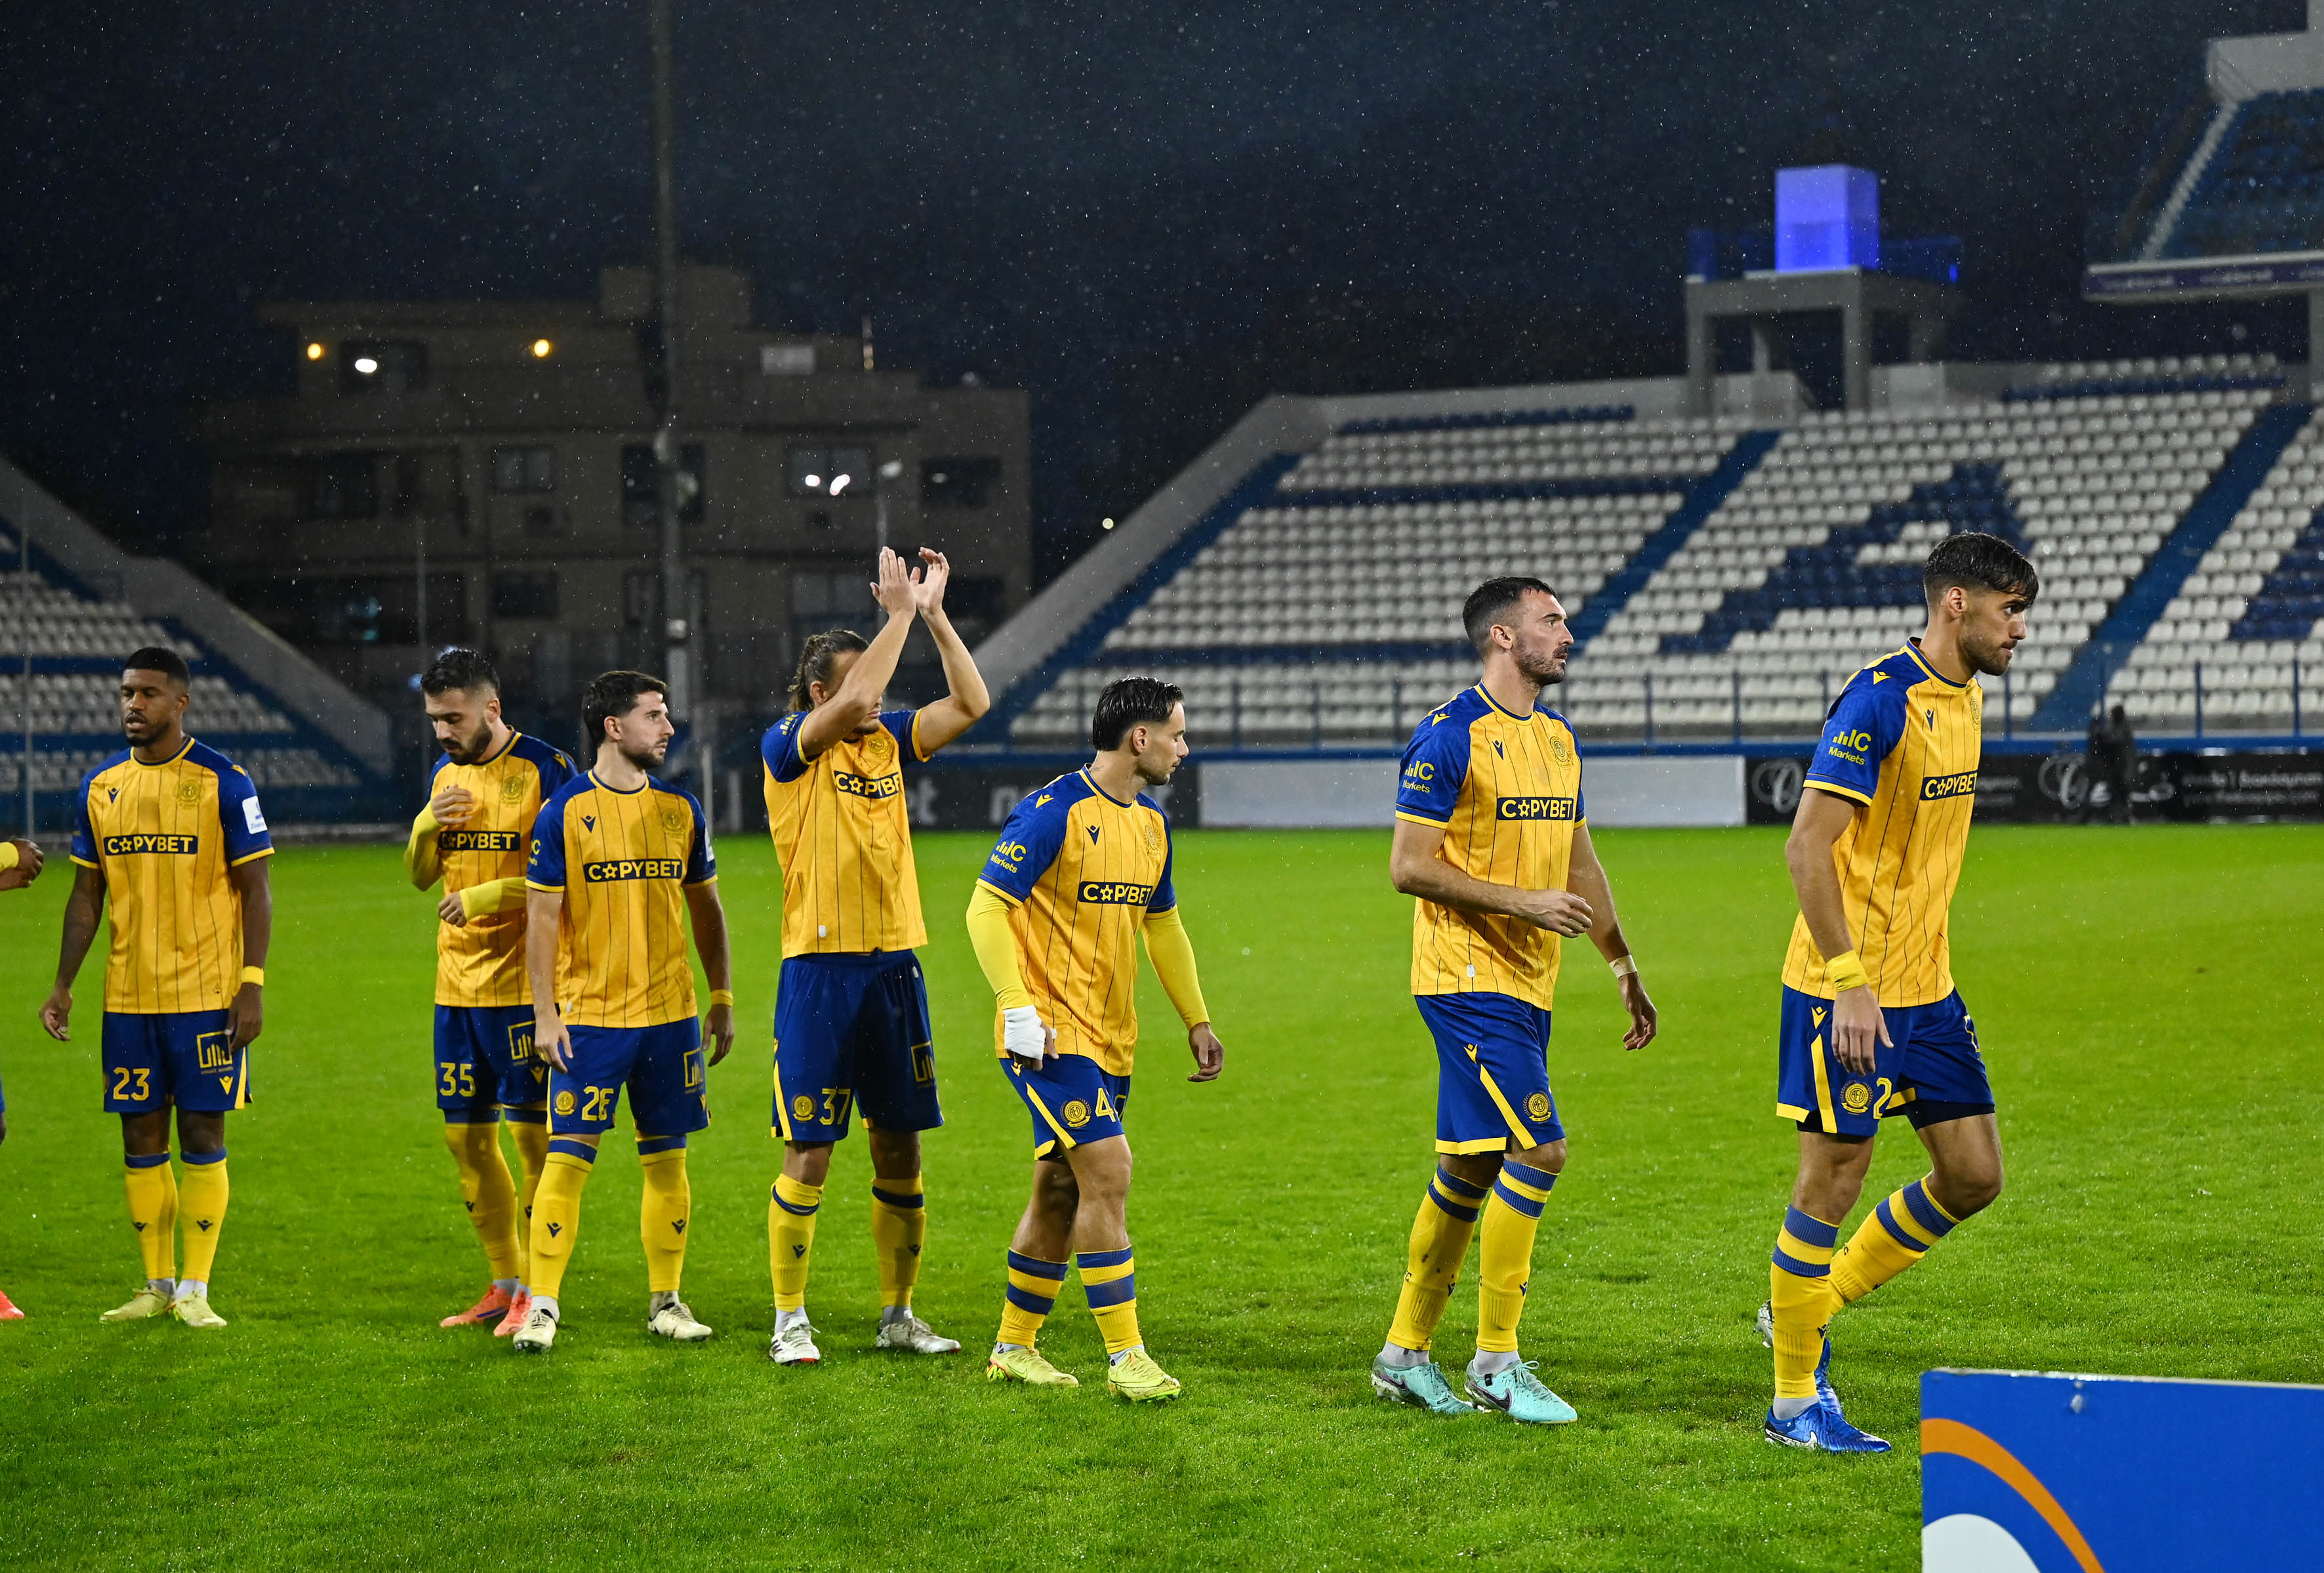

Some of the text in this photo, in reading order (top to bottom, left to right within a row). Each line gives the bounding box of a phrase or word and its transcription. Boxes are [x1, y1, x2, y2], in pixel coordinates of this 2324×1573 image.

[1828, 746, 1865, 766] Markets
[1402, 779, 1431, 793] Markets
[990, 853, 1018, 873] Markets
[113, 1067, 150, 1101] 23
[439, 1062, 476, 1097] 35
[820, 1088, 851, 1126] 37
